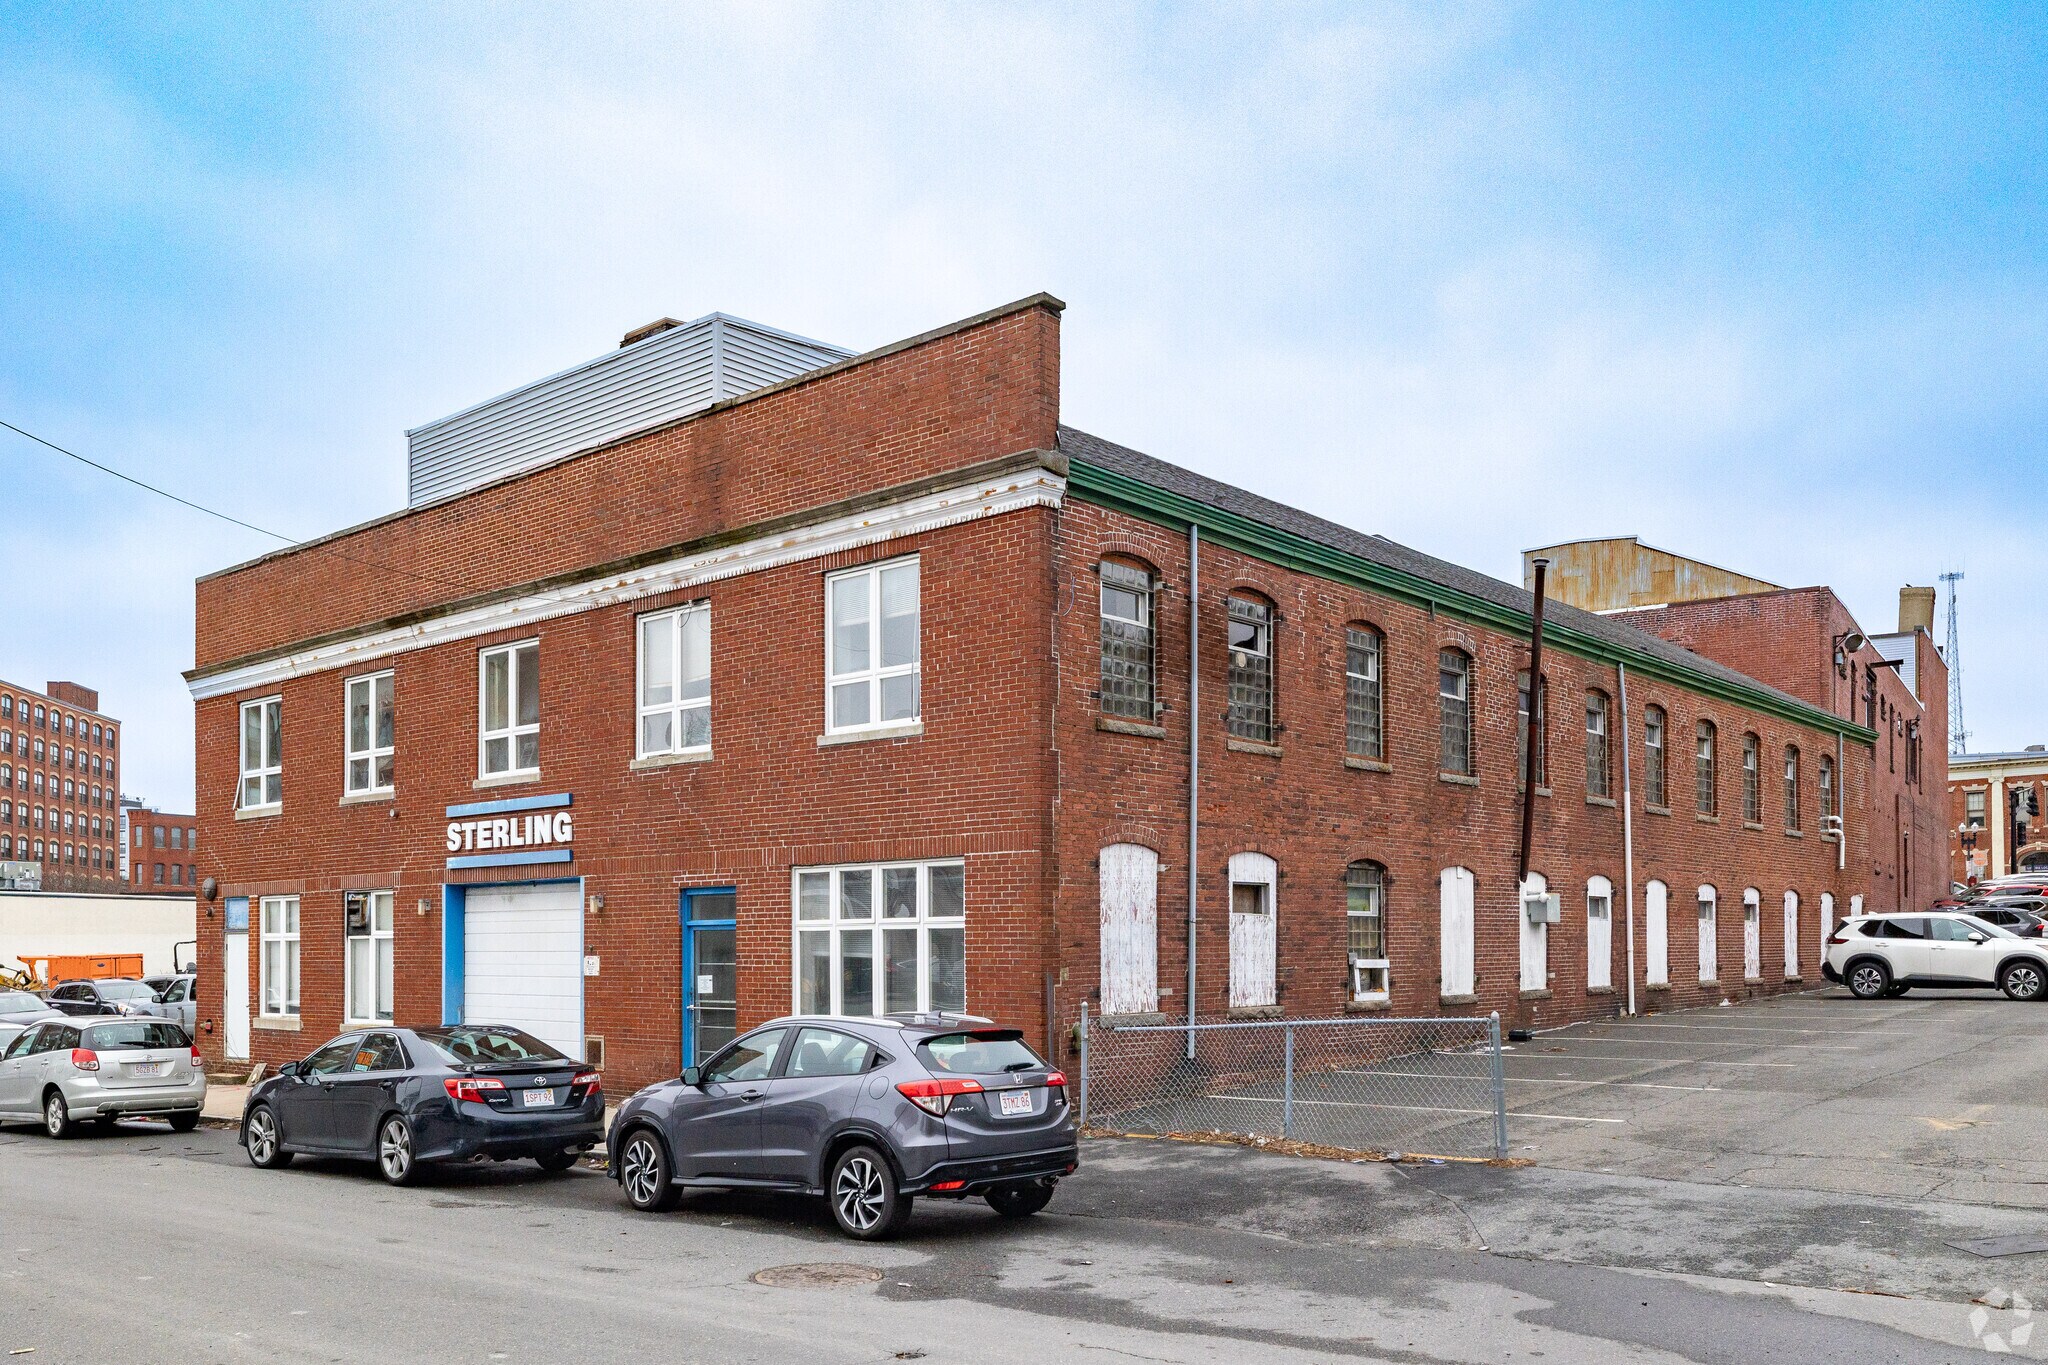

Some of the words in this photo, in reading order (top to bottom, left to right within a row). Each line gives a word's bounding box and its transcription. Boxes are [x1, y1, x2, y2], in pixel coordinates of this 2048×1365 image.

[446, 812, 573, 852] STERLING
[525, 1093, 542, 1103] 1SPT
[543, 1091, 553, 1102] 92
[1002, 1096, 1020, 1109] 3TMZ
[1020, 1096, 1030, 1107] 86
